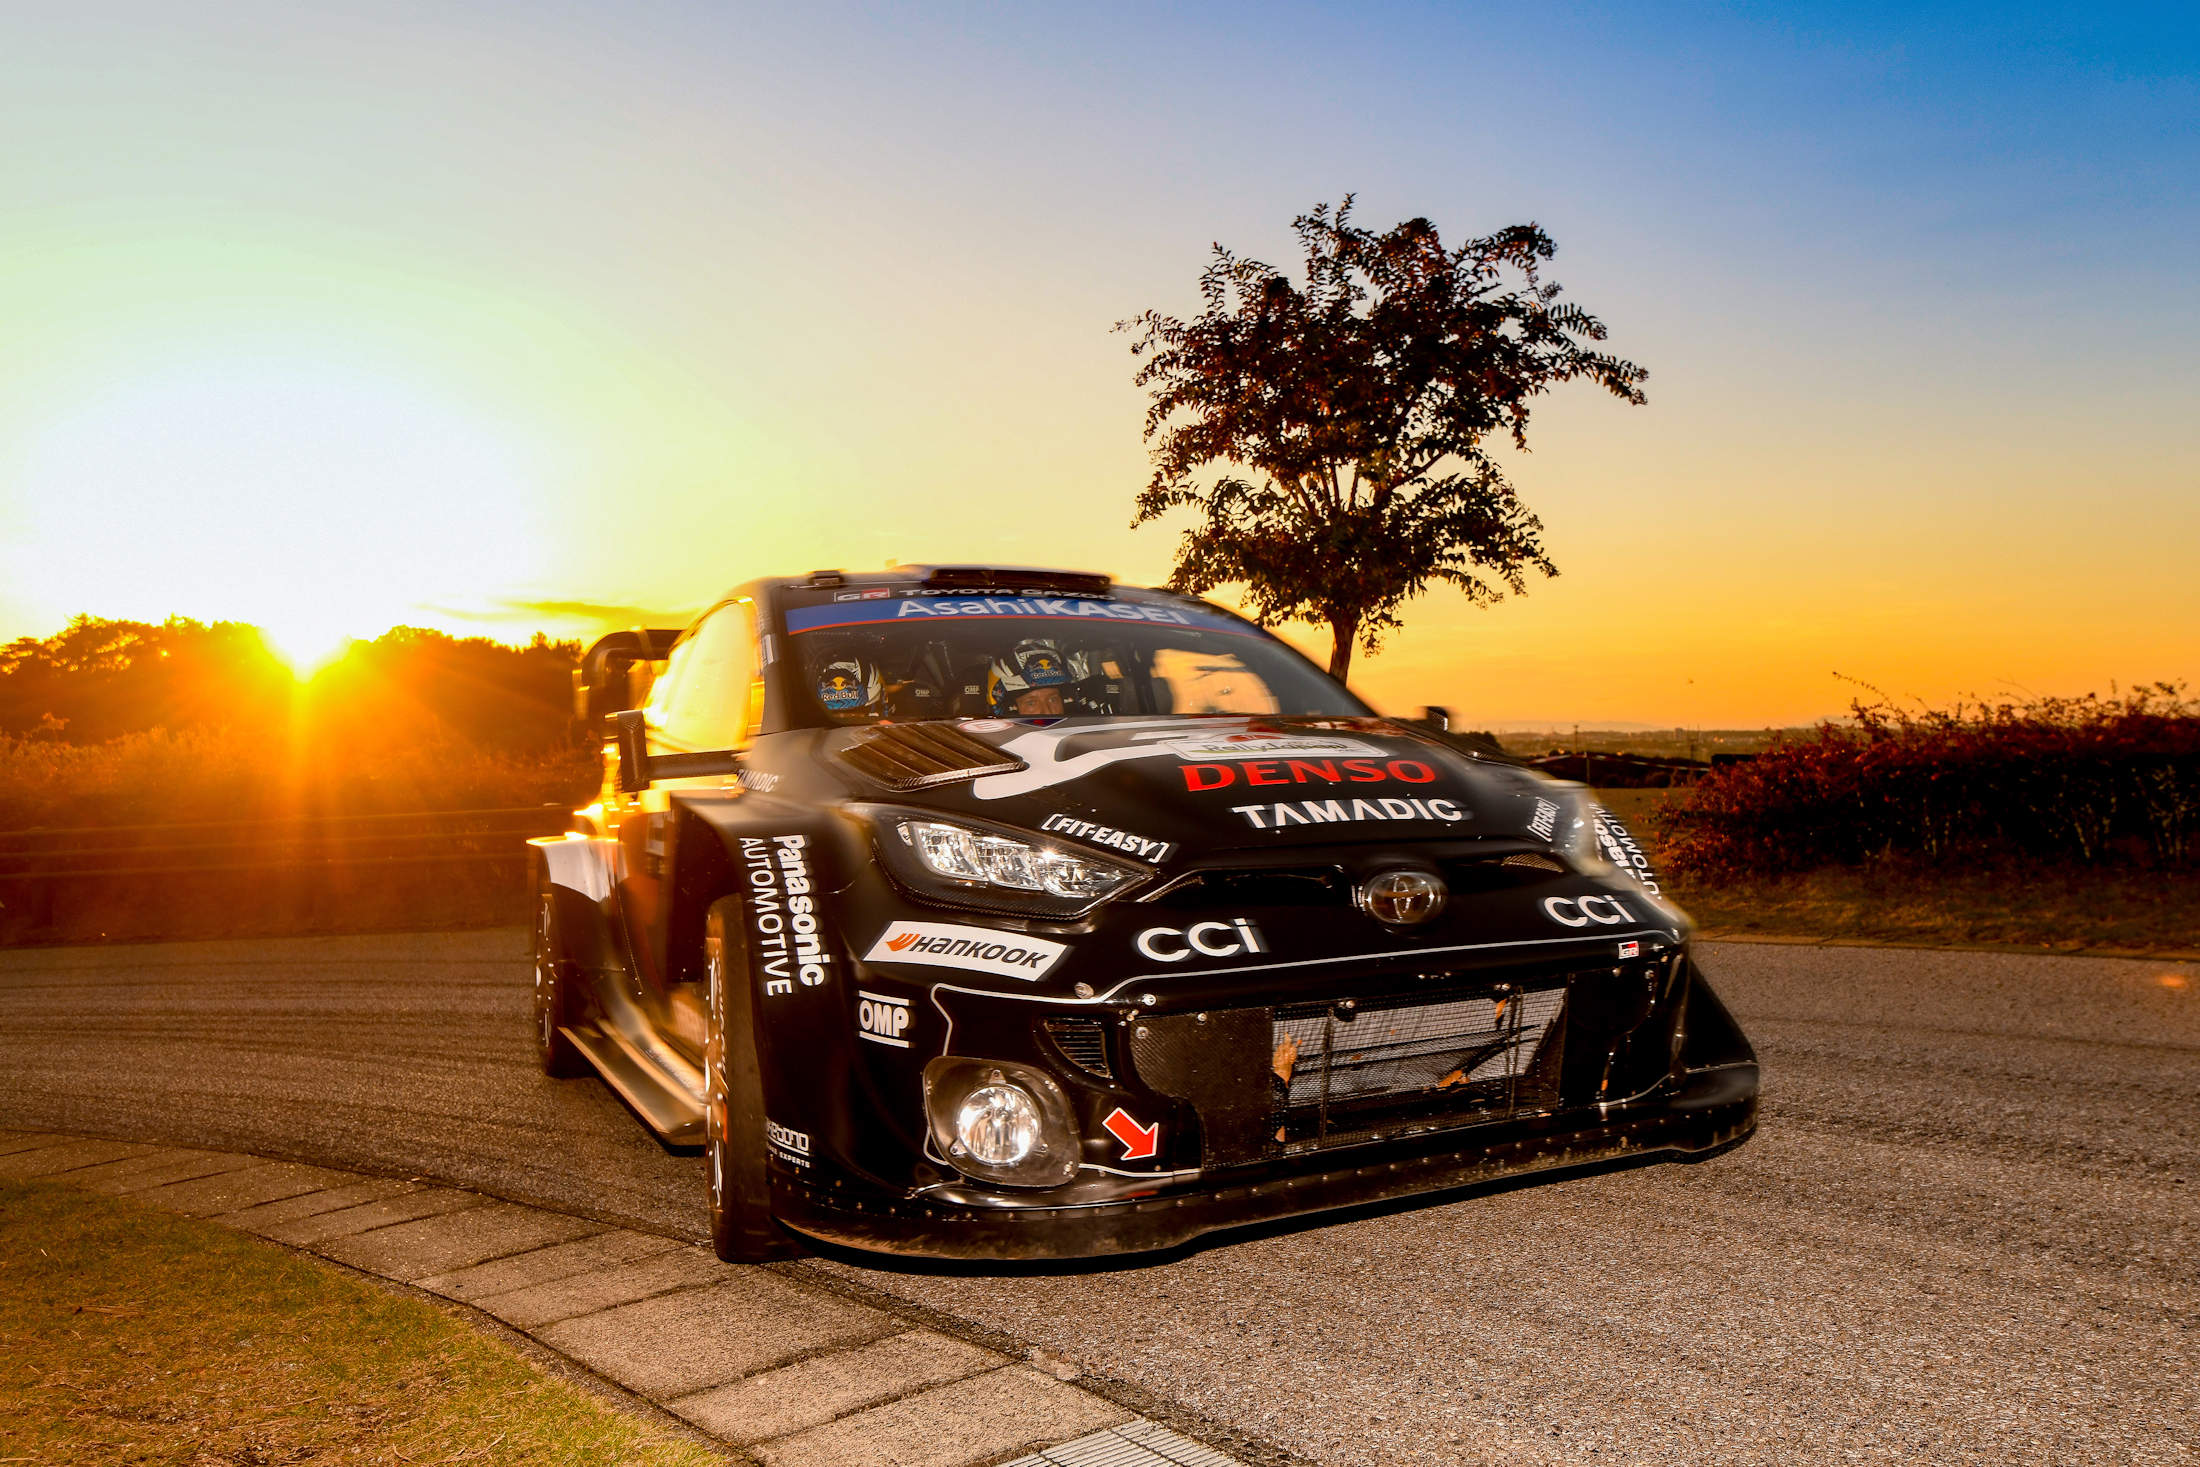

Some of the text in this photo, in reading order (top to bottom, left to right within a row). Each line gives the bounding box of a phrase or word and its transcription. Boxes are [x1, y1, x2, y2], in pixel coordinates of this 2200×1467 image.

[836, 589, 890, 602] GR
[899, 588, 1116, 600] TOYOTA GAZOO
[823, 690, 858, 701] Red Bull
[1178, 759, 1436, 792] DENSO
[1232, 798, 1464, 829] TAMADIC
[739, 837, 793, 996] AUTOMOTIVE
[773, 834, 826, 987] Panasonic
[858, 1004, 910, 1037] OMP
[779, 1151, 811, 1168] EXPERTS
